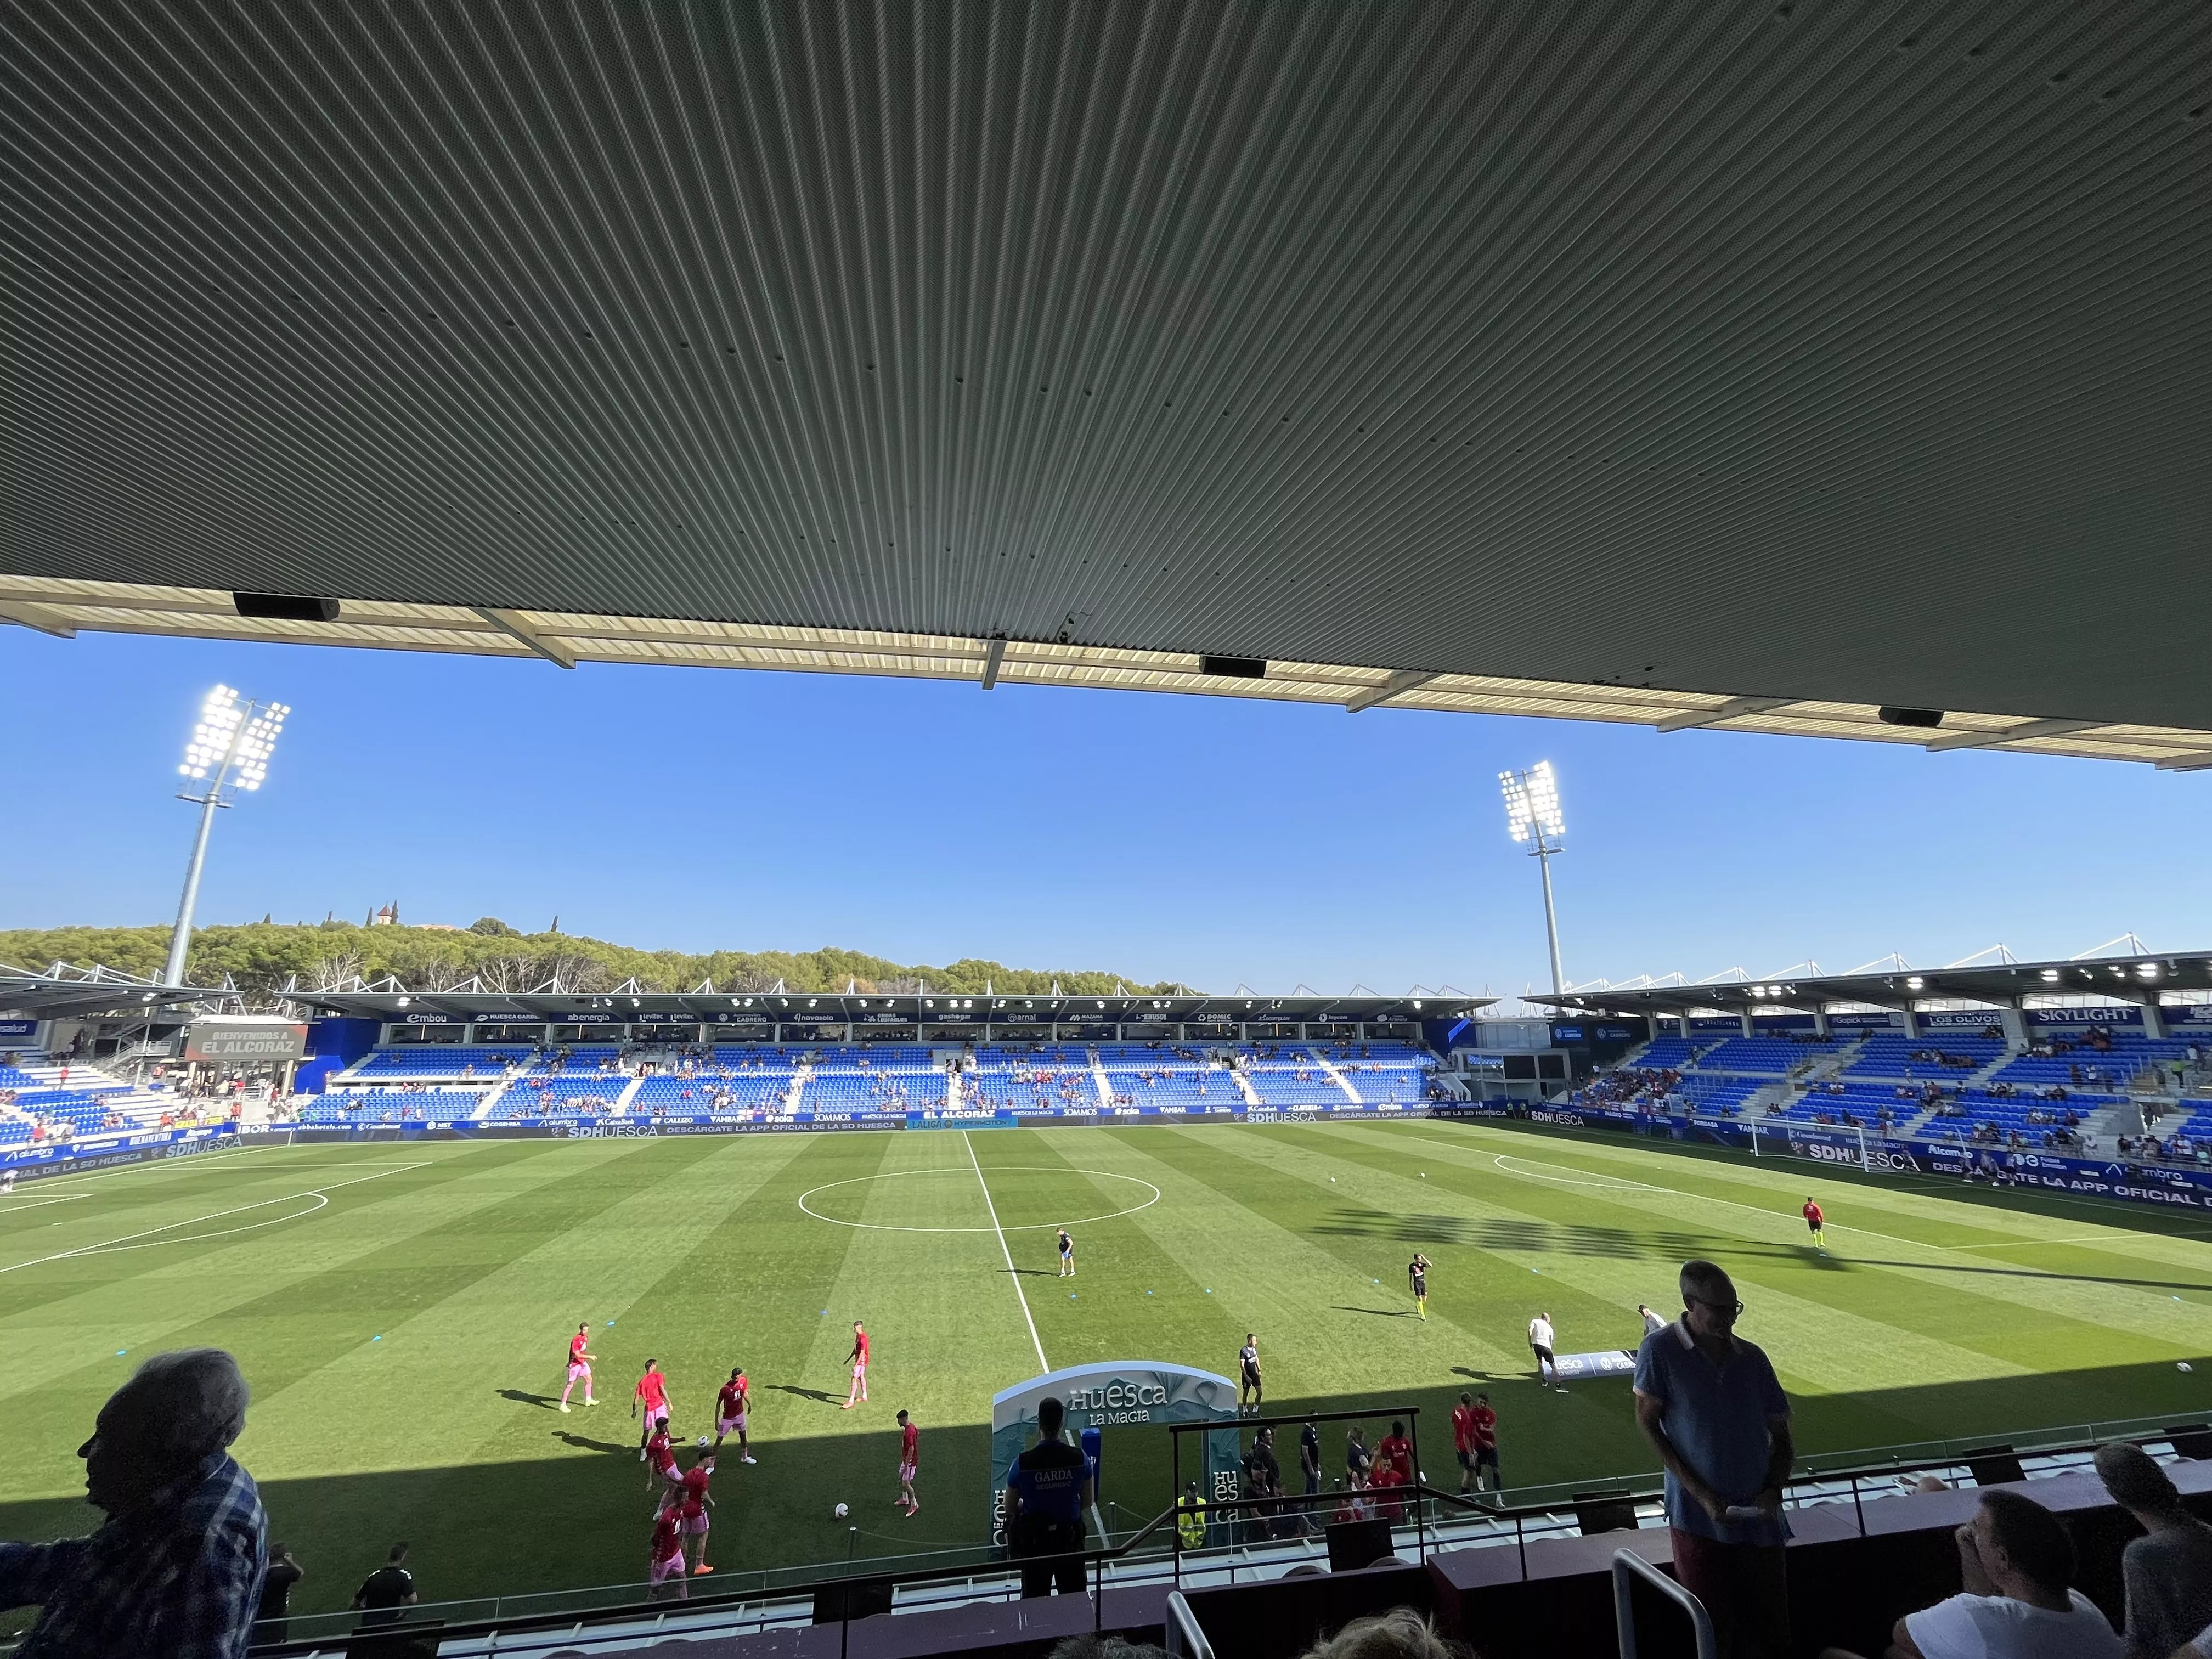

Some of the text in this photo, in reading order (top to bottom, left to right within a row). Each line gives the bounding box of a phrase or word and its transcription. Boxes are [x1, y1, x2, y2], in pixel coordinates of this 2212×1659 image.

[407, 1013, 447, 1023] embou
[2038, 1009, 2134, 1021] SKYLIGHT
[212, 1032, 279, 1040] BIENVENIDOS
[202, 1041, 295, 1053] EL ALCORAZ
[814, 1113, 851, 1122] SOMMOS
[941, 1110, 995, 1119] ALCORAZ
[912, 1120, 942, 1129] LALIGA
[568, 1126, 658, 1138] SDHUESCA
[166, 1136, 242, 1158] SDHUESCA
[43, 1165, 60, 1175] DE
[63, 1163, 77, 1172] LA
[80, 1159, 96, 1169] SD
[99, 1153, 142, 1166] HUESCA
[2042, 1176, 2067, 1187] LA
[2070, 1180, 2108, 1192] APP
[2114, 1185, 2200, 1205] OFICIAL
[1554, 1359, 1584, 1370] uesca
[1070, 1384, 1167, 1410] Huesca
[1035, 1470, 1074, 1482] GARDA
